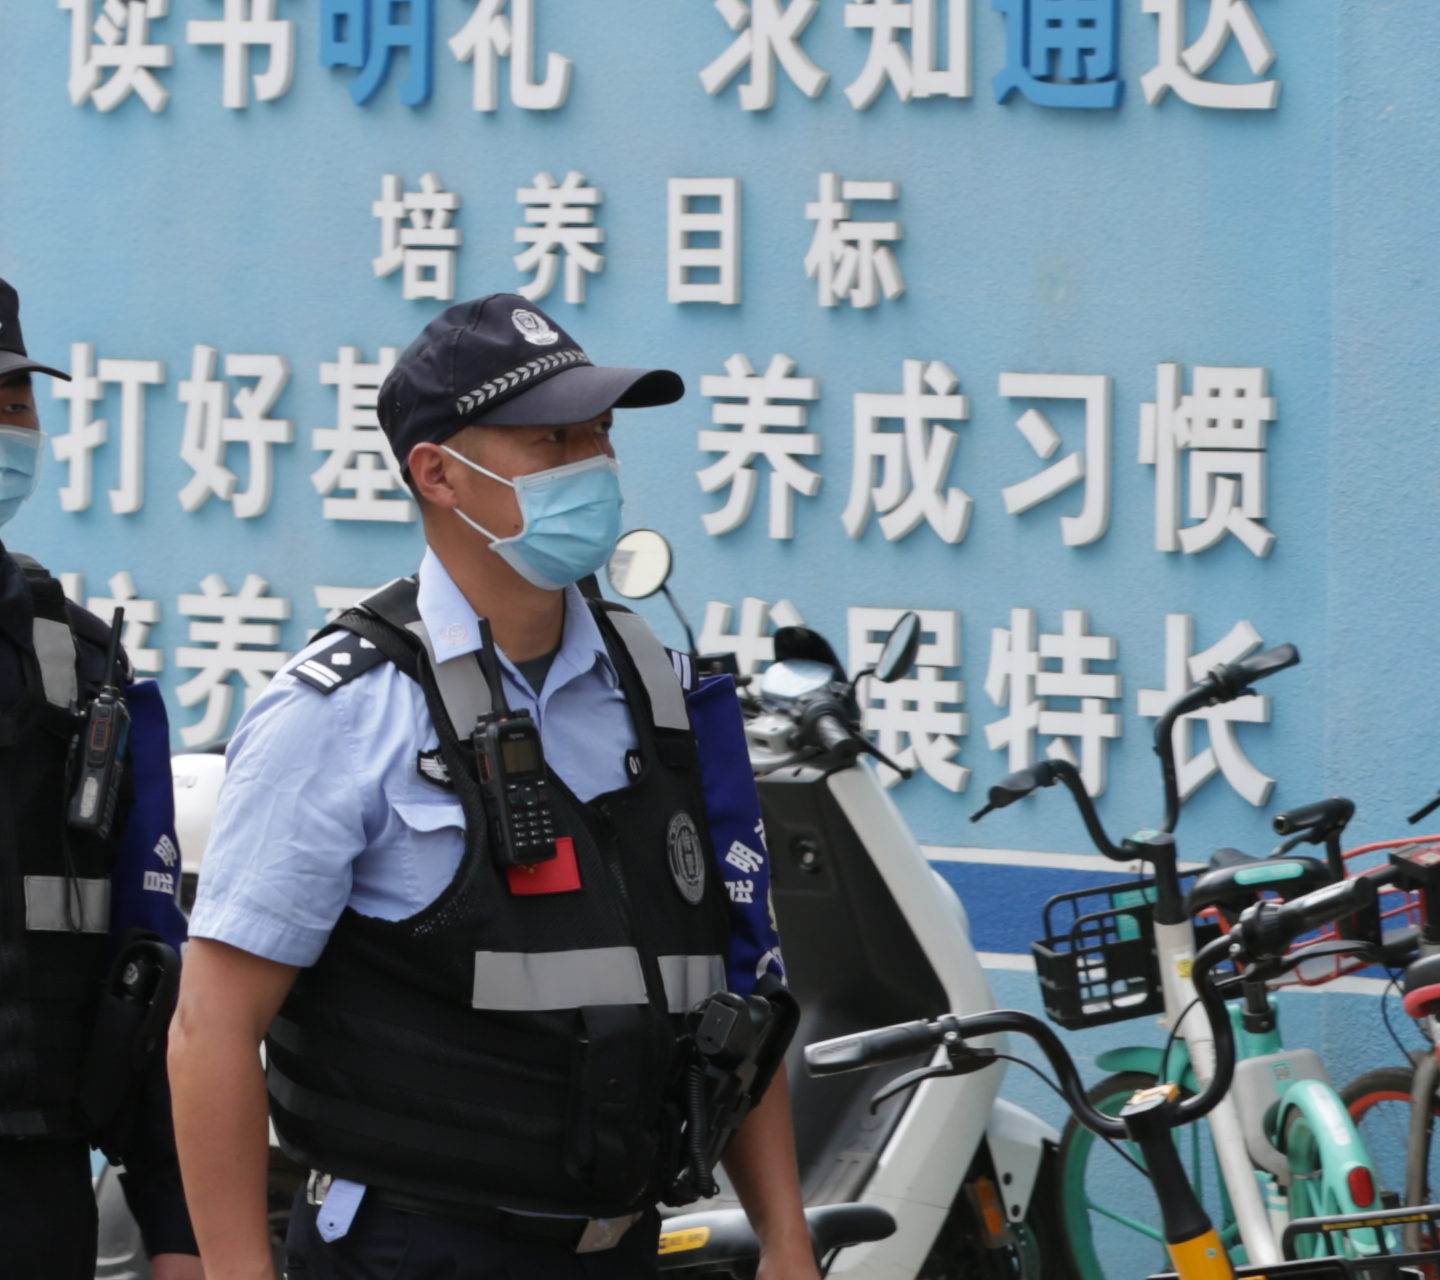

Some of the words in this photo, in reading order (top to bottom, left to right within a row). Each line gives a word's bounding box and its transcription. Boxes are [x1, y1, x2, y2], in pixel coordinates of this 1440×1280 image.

[372, 171, 905, 309] 培养目标
[51, 341, 417, 523] 打好基
[696, 353, 1277, 558] 养成习惯
